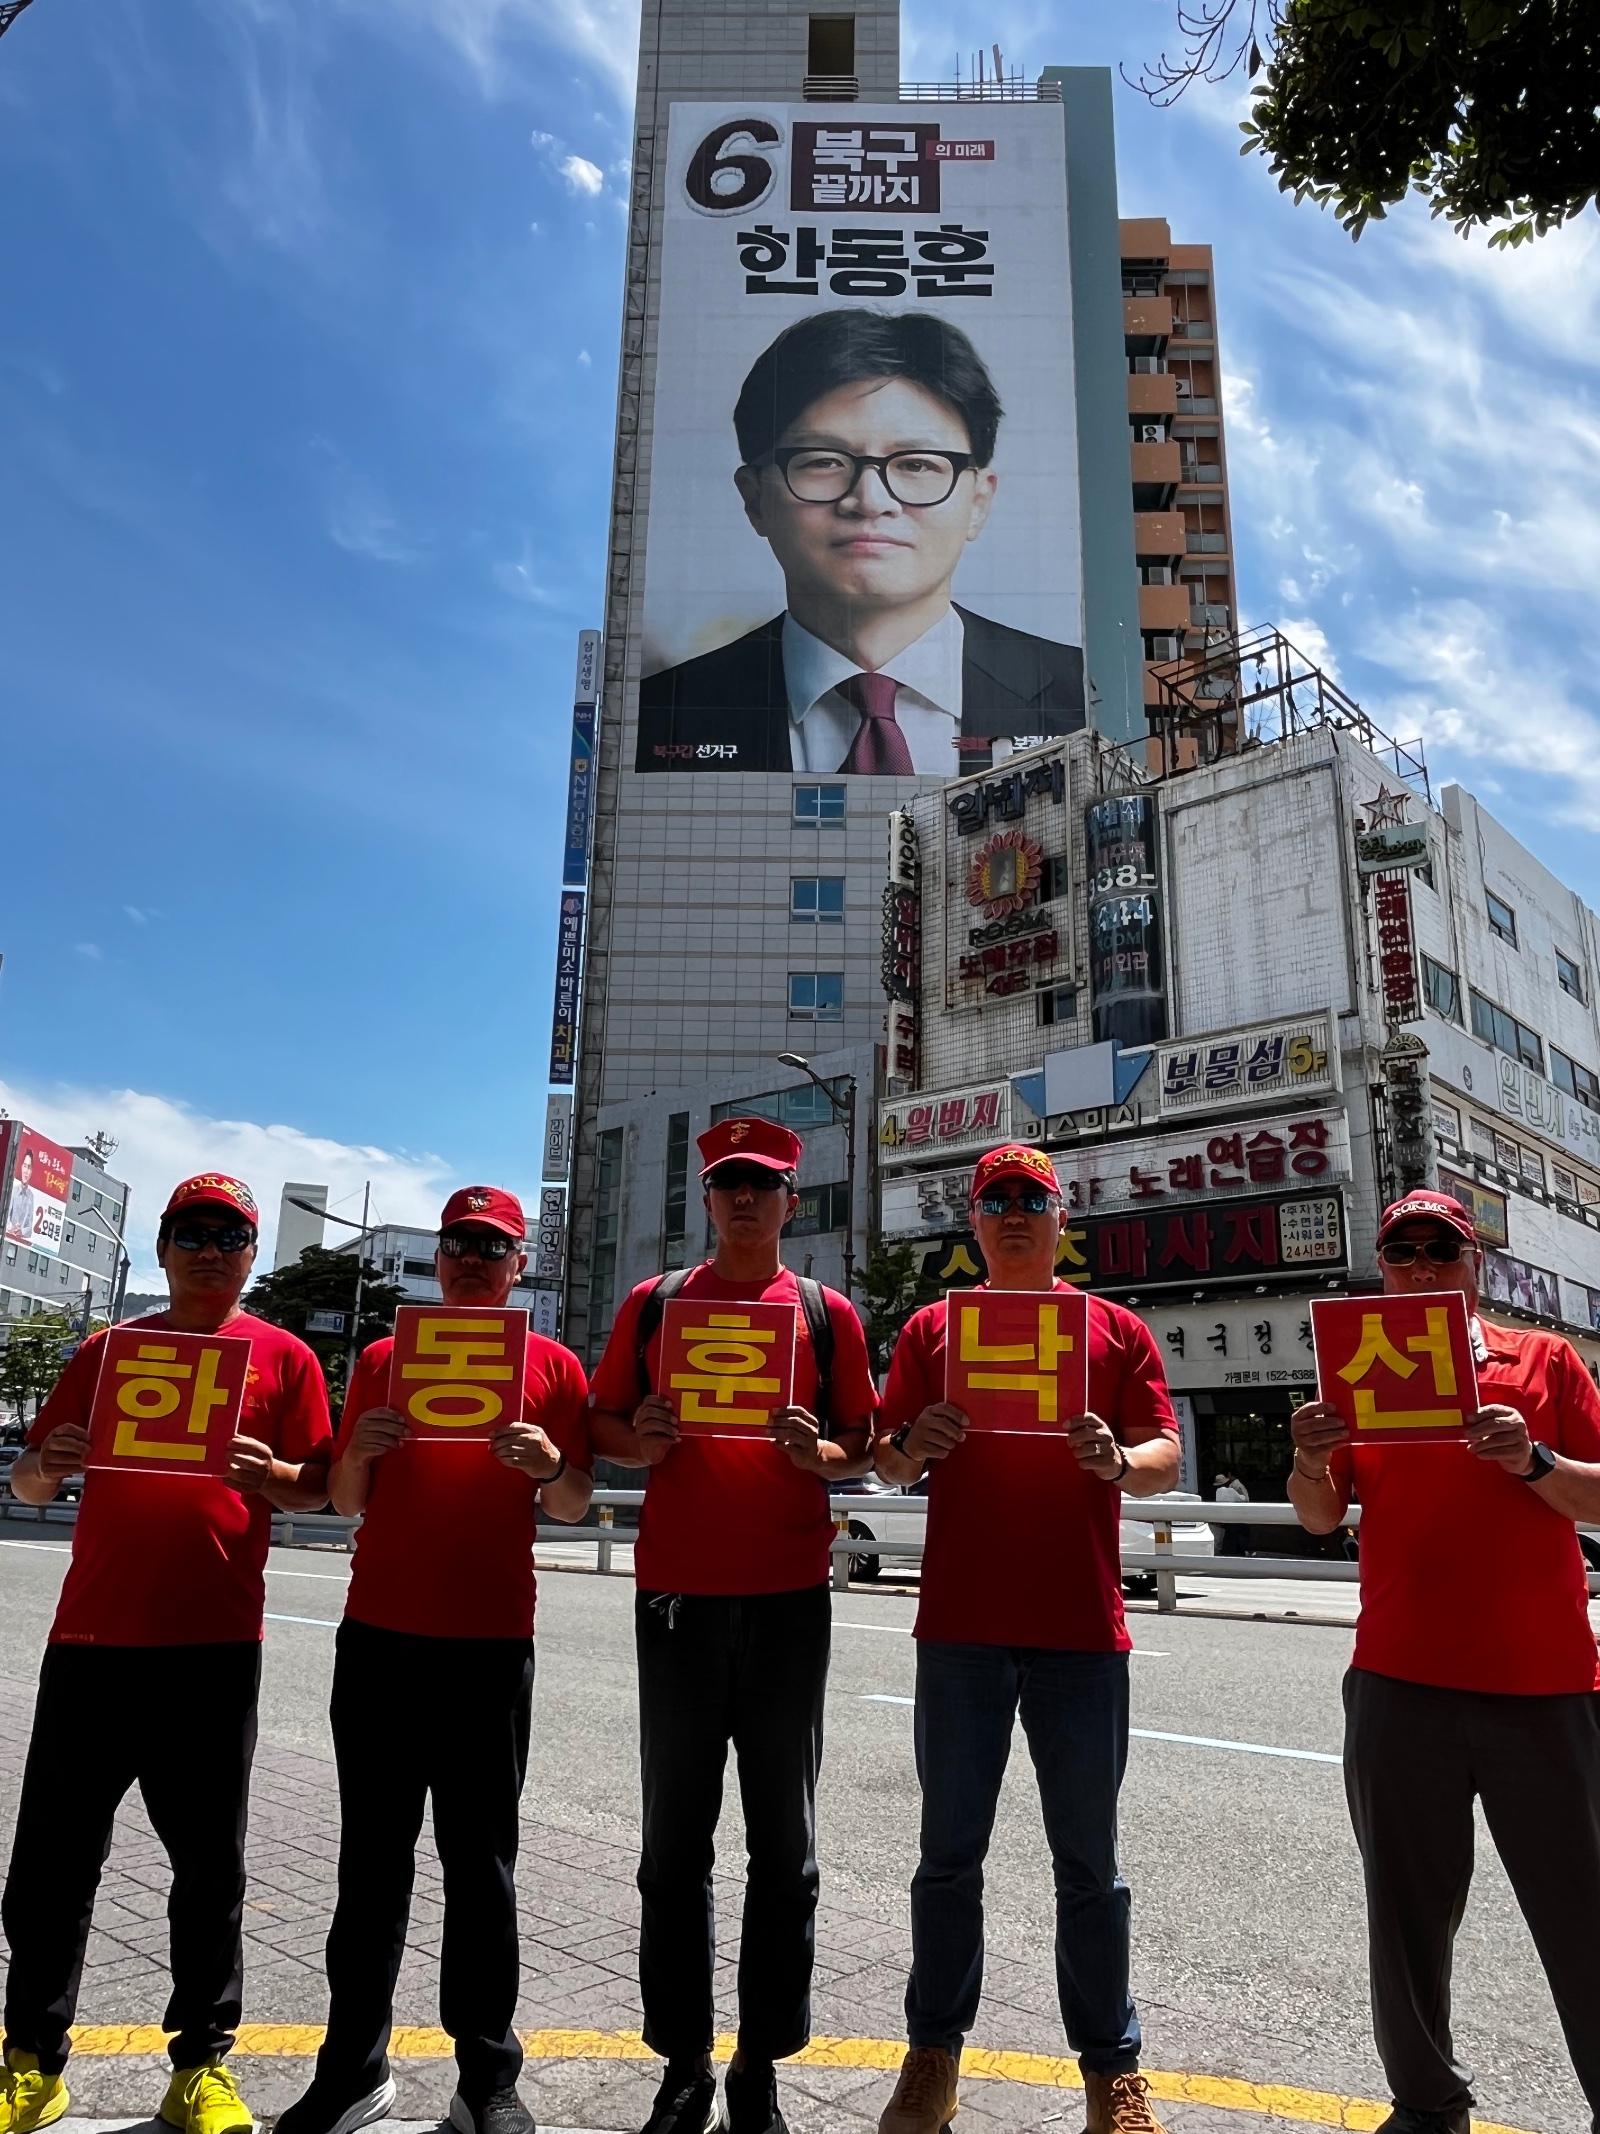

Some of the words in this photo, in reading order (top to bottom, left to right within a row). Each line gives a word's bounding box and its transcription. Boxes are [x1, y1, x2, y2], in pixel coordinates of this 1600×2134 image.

[685, 118, 779, 210] 6
[812, 129, 919, 173] 북구
[934, 143, 951, 158] 의
[955, 143, 986, 158] 미래
[811, 174, 920, 205] 끝까지
[736, 224, 995, 297] 한동훈
[695, 744, 738, 759] 선거구
[951, 759, 1065, 836] 일번지
[1165, 1036, 1284, 1096] 보물섬
[1288, 1035, 1327, 1075] 5F
[1500, 1056, 1565, 1138] 일번지
[905, 1092, 1000, 1144] 일번지
[1129, 1118, 1329, 1199] 노래연습장
[1098, 1205, 1278, 1278] 마사지
[1391, 1200, 1449, 1218] ROKMC
[402, 1318, 513, 1427] 동
[670, 1314, 781, 1426] 훈
[960, 1304, 1074, 1422] 낙
[1336, 1306, 1464, 1431] 선
[112, 1344, 229, 1462] 한
